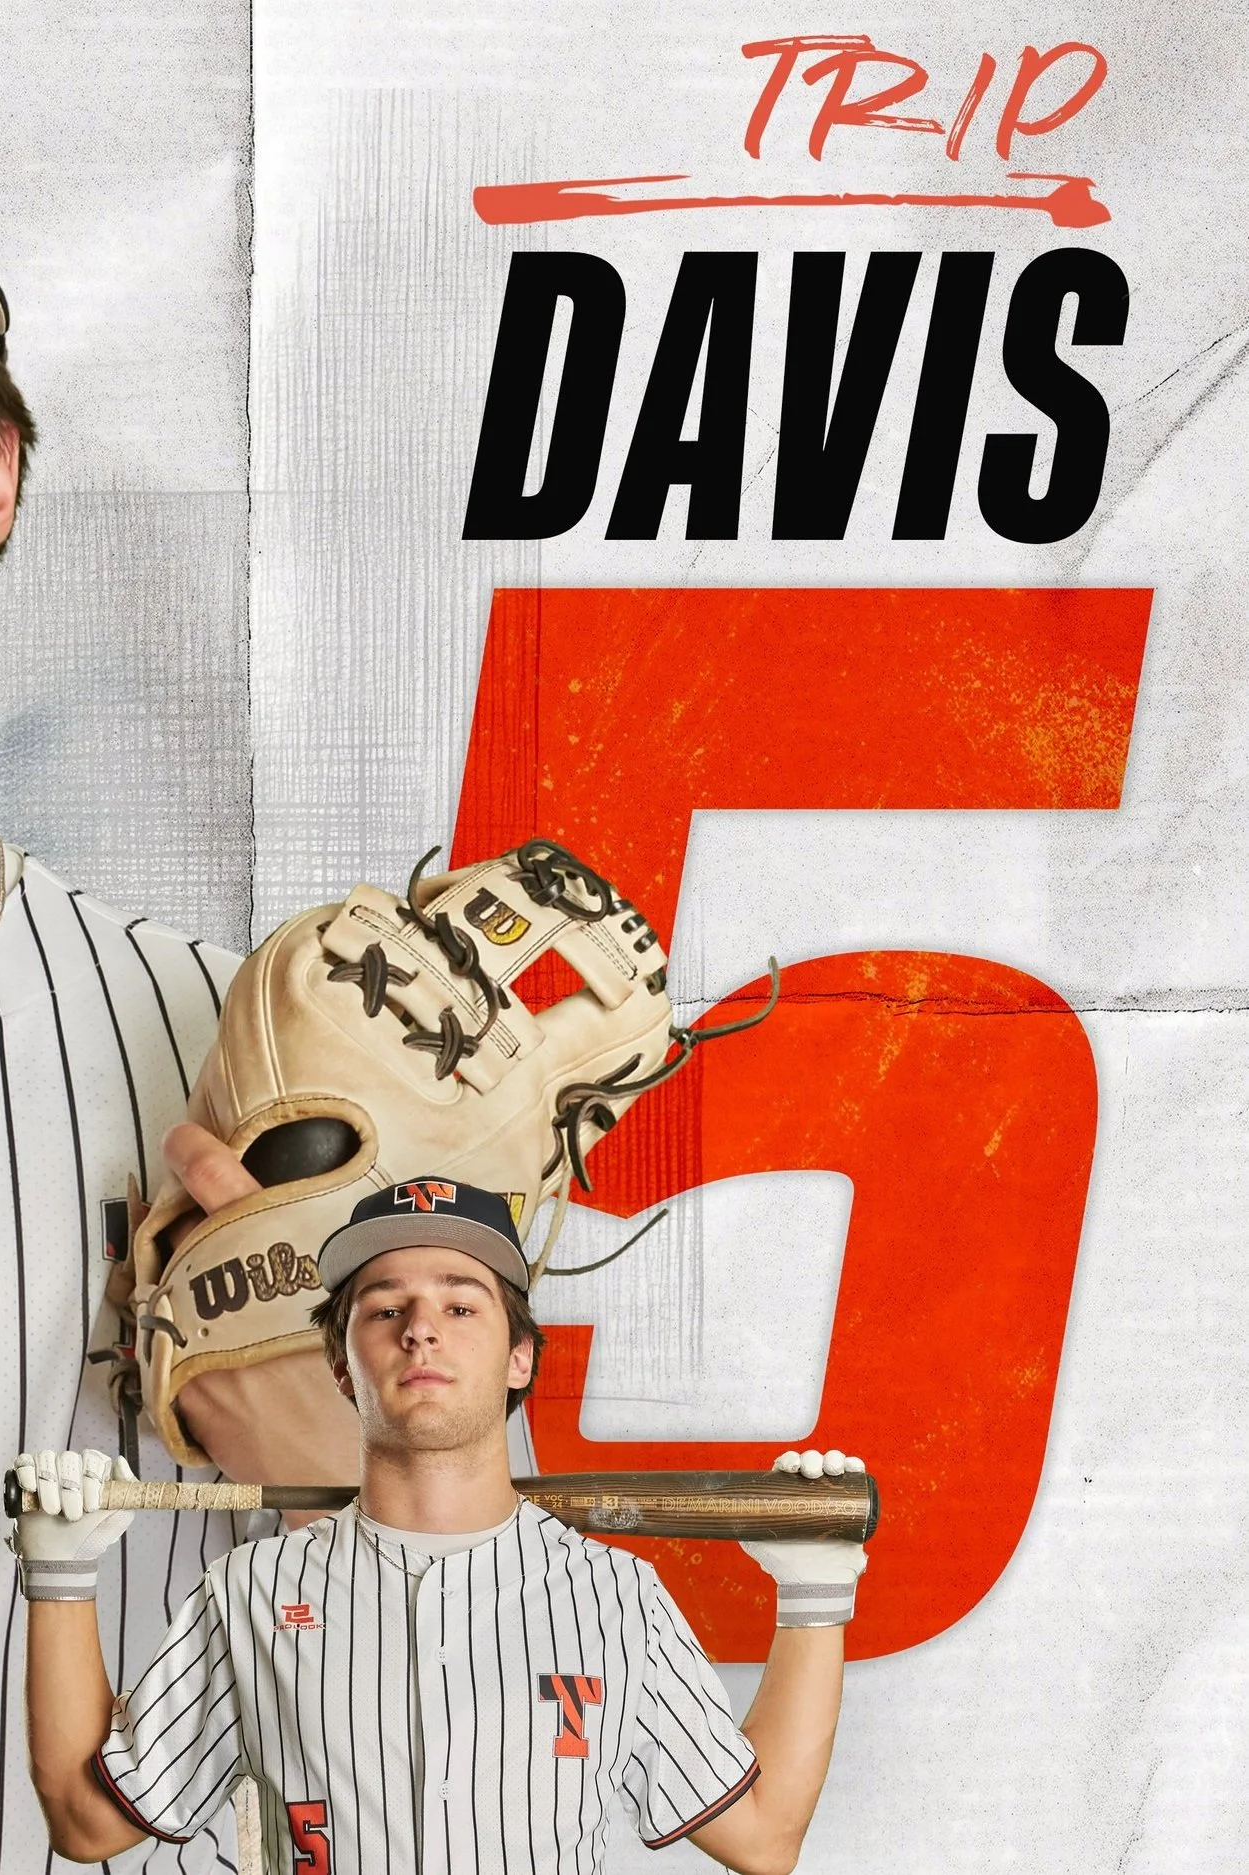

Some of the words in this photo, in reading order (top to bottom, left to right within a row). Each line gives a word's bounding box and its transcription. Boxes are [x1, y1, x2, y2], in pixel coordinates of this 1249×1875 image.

[741, 33, 1110, 162] TRIP
[461, 246, 1131, 545] DAVIS
[447, 587, 1155, 1664] 5
[189, 1241, 323, 1321] Wils
[662, 1496, 760, 1513] DEMARINI
[536, 1672, 603, 1760] T
[285, 1799, 333, 1875] 5
